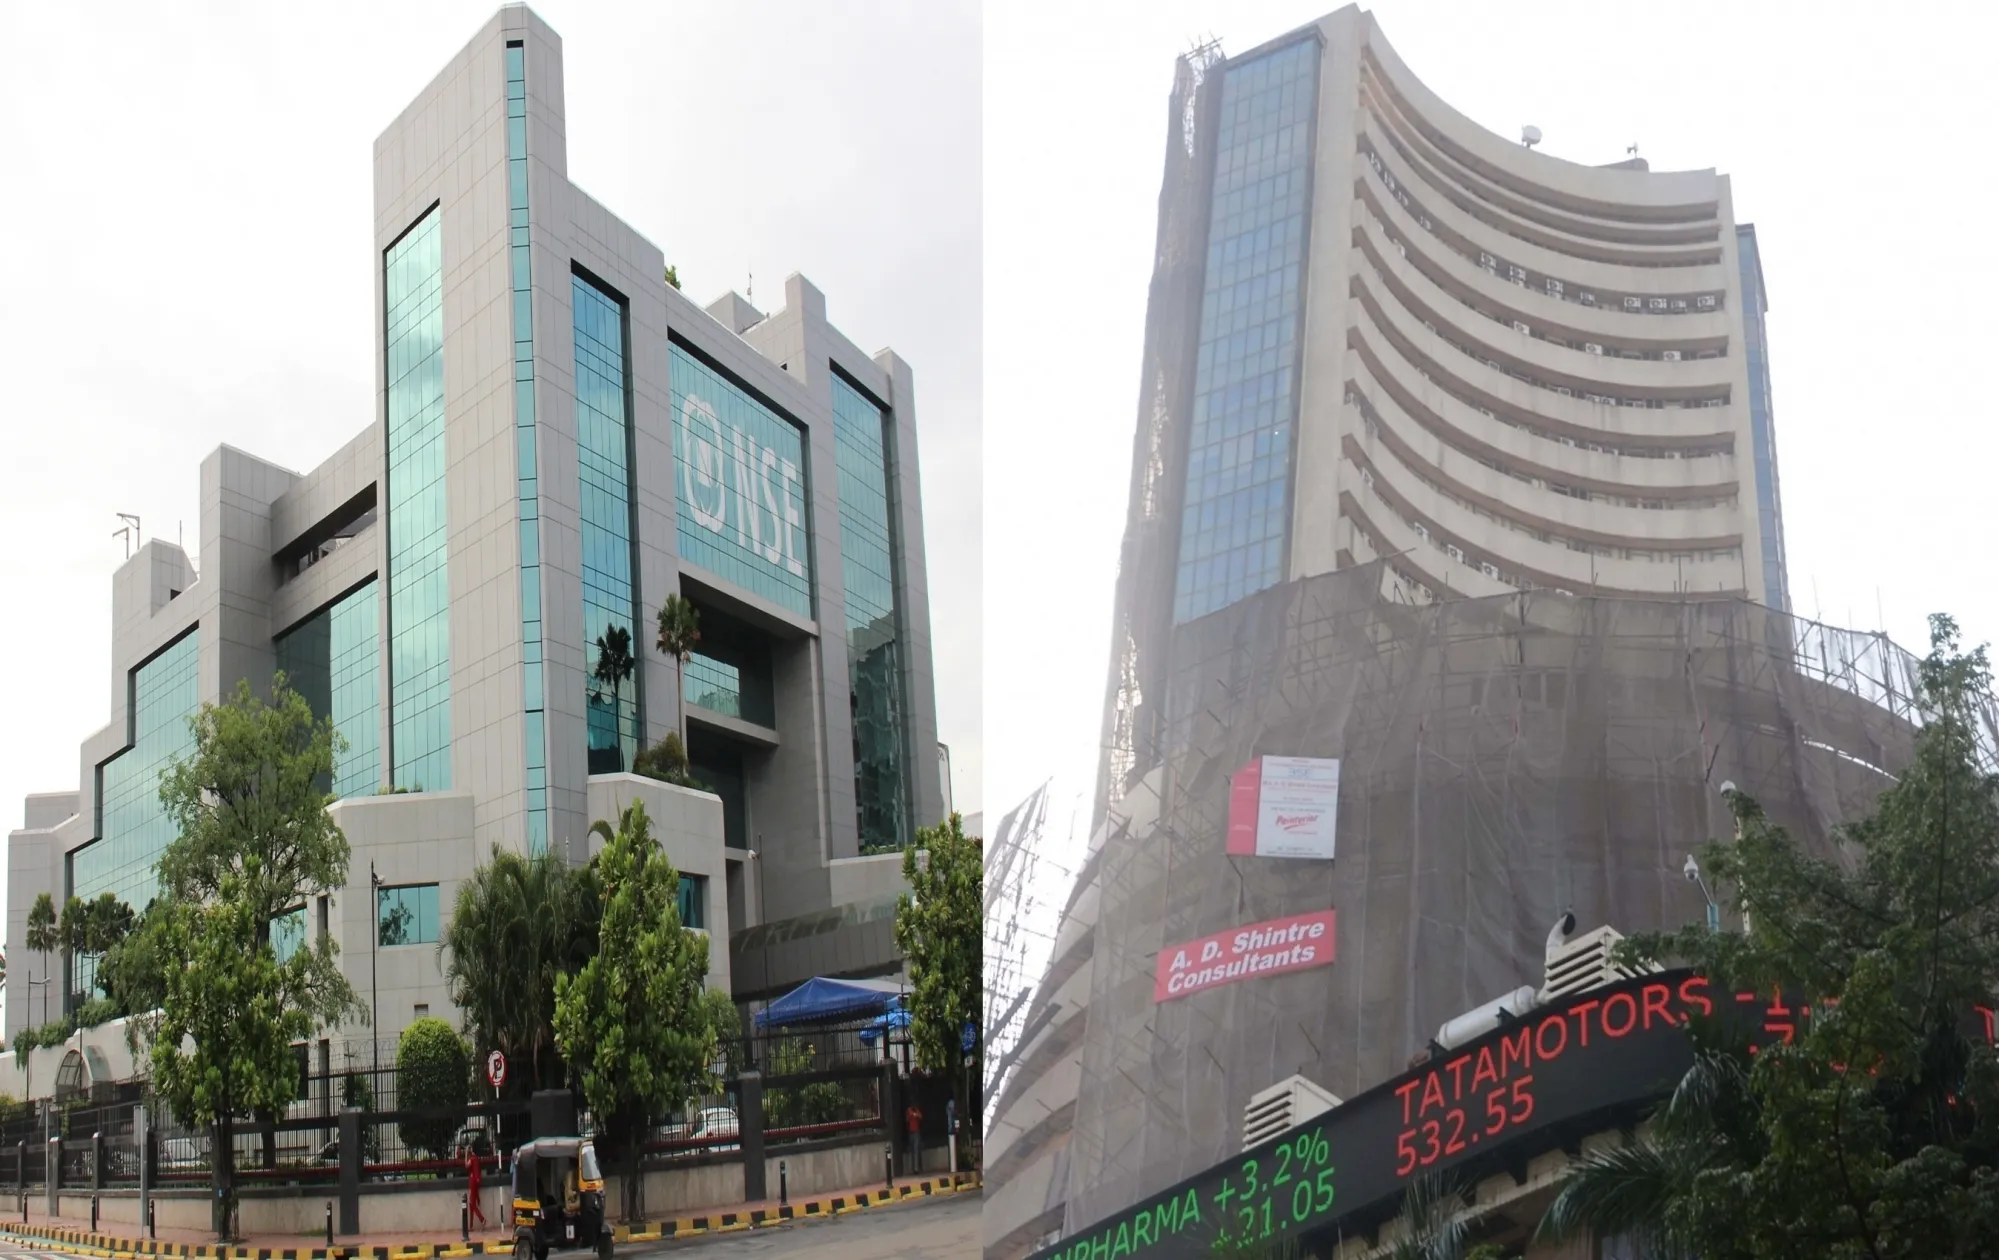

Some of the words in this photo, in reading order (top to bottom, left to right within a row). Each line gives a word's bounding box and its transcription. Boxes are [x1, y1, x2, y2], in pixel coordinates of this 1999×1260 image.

[733, 424, 803, 577] NSE
[1167, 945, 1316, 994] Consultants
[1169, 950, 1193, 973] A.
[1201, 941, 1224, 963] D.
[1231, 921, 1326, 955] Shintre
[1394, 975, 1714, 1125] TATAMOTORS
[1213, 1126, 1330, 1213] +3.2%
[1396, 1074, 1535, 1177] 532.55
